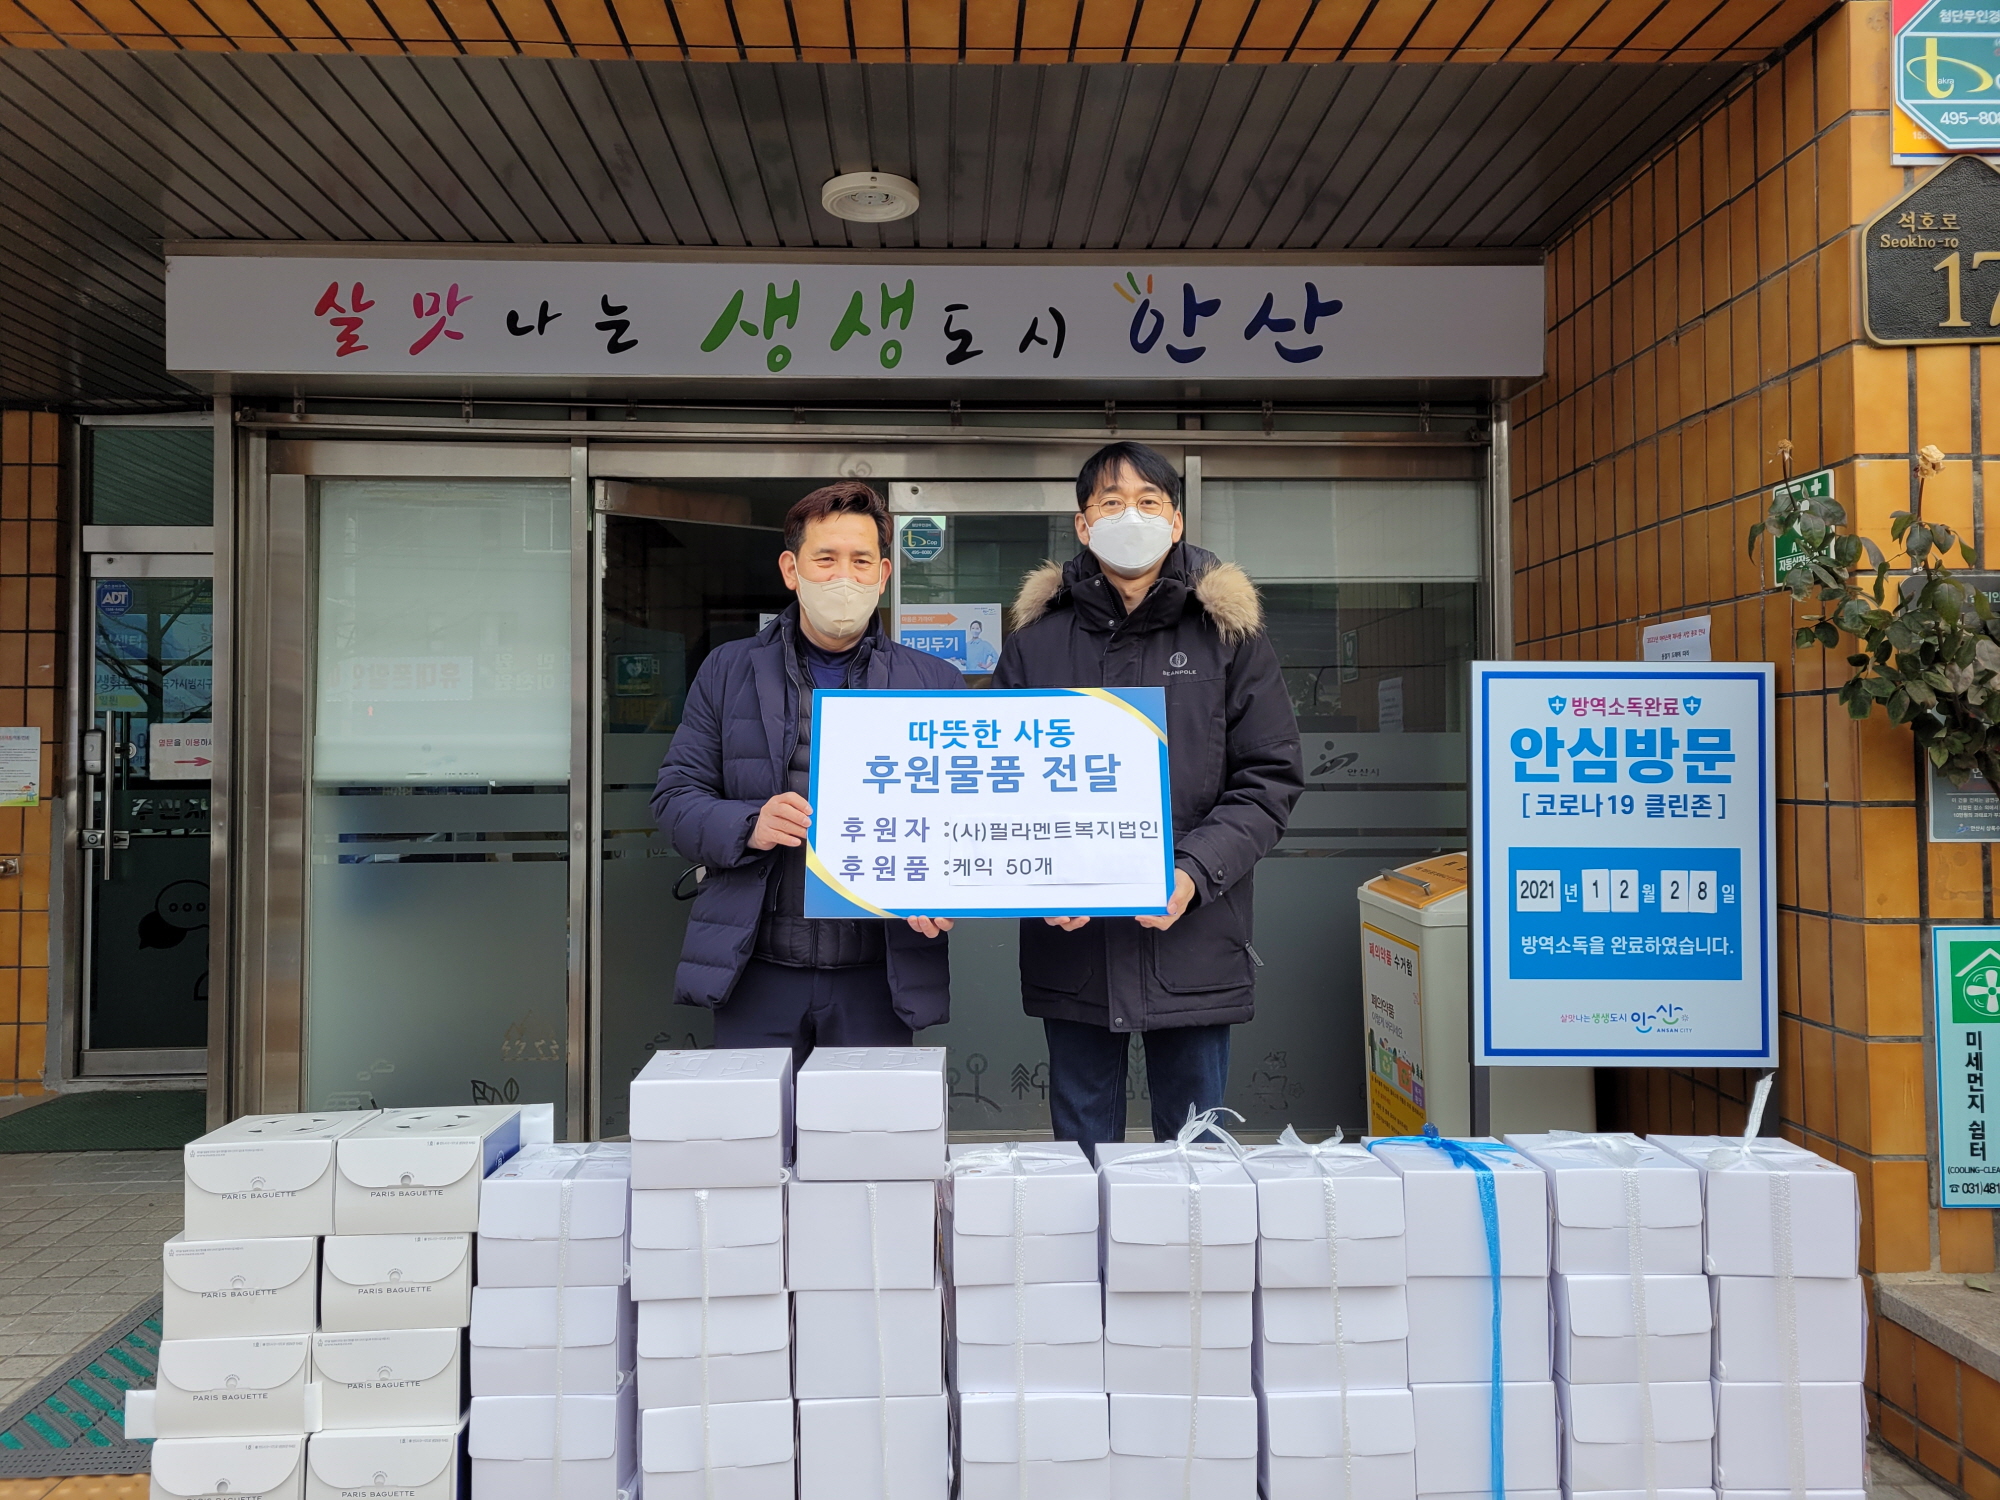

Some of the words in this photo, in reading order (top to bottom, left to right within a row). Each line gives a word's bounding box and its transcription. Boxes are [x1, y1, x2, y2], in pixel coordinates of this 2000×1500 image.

[1940, 111, 2000, 125] 495-80
[1897, 211, 1961, 232] 석호로
[1880, 234, 1960, 249] Seokho-ro
[1129, 281, 1343, 364] 안산
[101, 591, 128, 605] ADT
[1571, 696, 1680, 717] 방역소독완료
[908, 718, 1002, 750] 따뜻한
[1013, 718, 1076, 749] 사동
[1509, 726, 1737, 784] 안심방문
[862, 754, 1026, 795] 후원물품
[1042, 752, 1122, 793] 전달
[1346, 768, 1380, 778] 안산시
[952, 857, 994, 877] 케익
[1005, 856, 1054, 877] 50개
[1520, 934, 1606, 956] 방역소독을
[1610, 934, 1735, 956] 완료하였습니다.
[1968, 1120, 1987, 1161] 쉼터
[250, 1191, 297, 1199] BAGUETTE
[370, 1190, 396, 1198] PARIS
[398, 1189, 444, 1197] BAGUETTE
[201, 1291, 227, 1299] PARIS
[230, 1288, 277, 1298] BAGUETTE
[358, 1287, 384, 1295] PARIS
[386, 1285, 432, 1294] BAGUETTE
[347, 1382, 373, 1390] PARIS
[375, 1380, 421, 1389] BAGUETTE
[192, 1394, 219, 1402] PARIS
[221, 1392, 268, 1400] BAGUETTE
[369, 1490, 415, 1498] BAGUETTE
